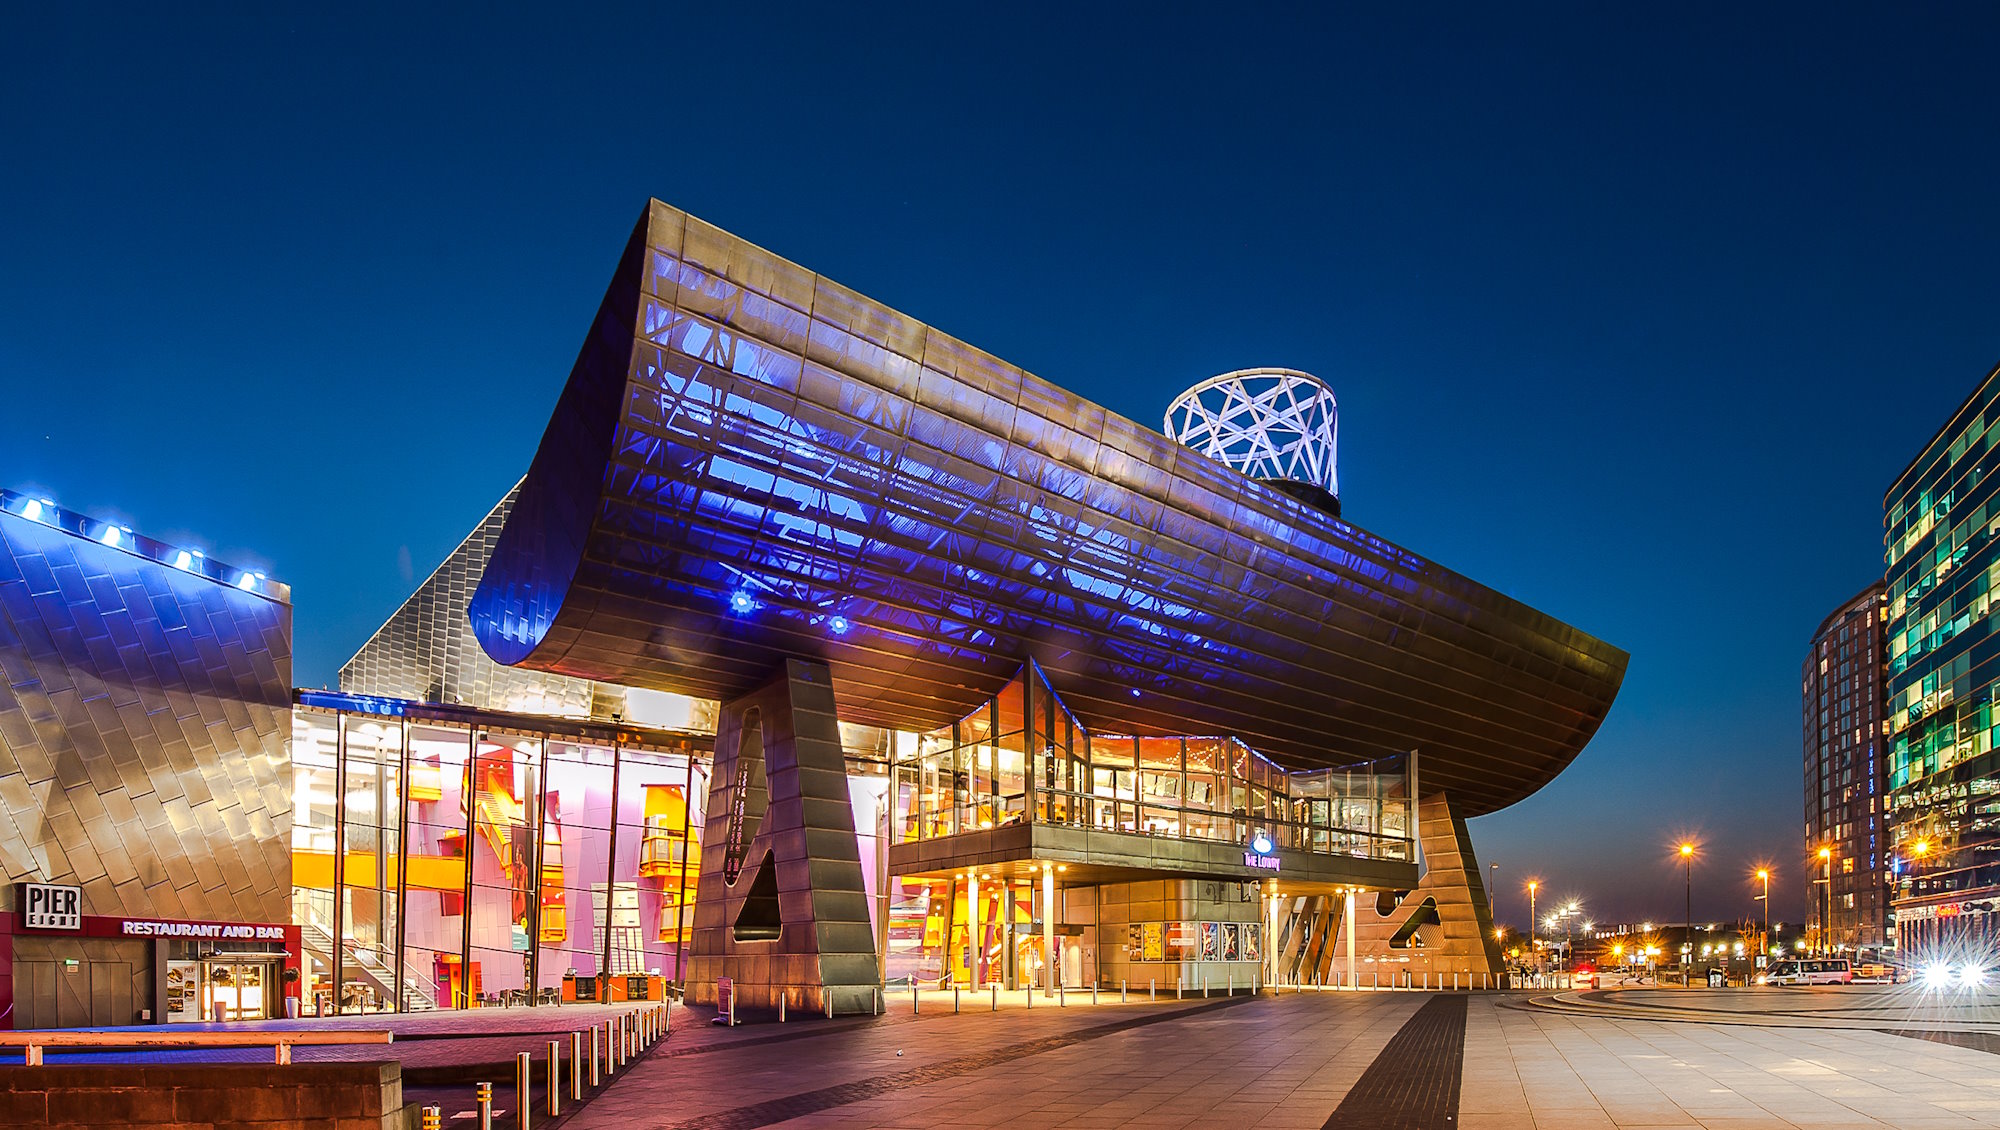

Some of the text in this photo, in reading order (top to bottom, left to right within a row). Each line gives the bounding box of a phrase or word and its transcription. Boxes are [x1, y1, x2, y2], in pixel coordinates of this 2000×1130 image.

[1244, 852, 1280, 872] THE LOWRY
[30, 887, 77, 915] PIER
[29, 914, 77, 926] EIGHT
[123, 921, 284, 939] RESTAURANT AND BAR
